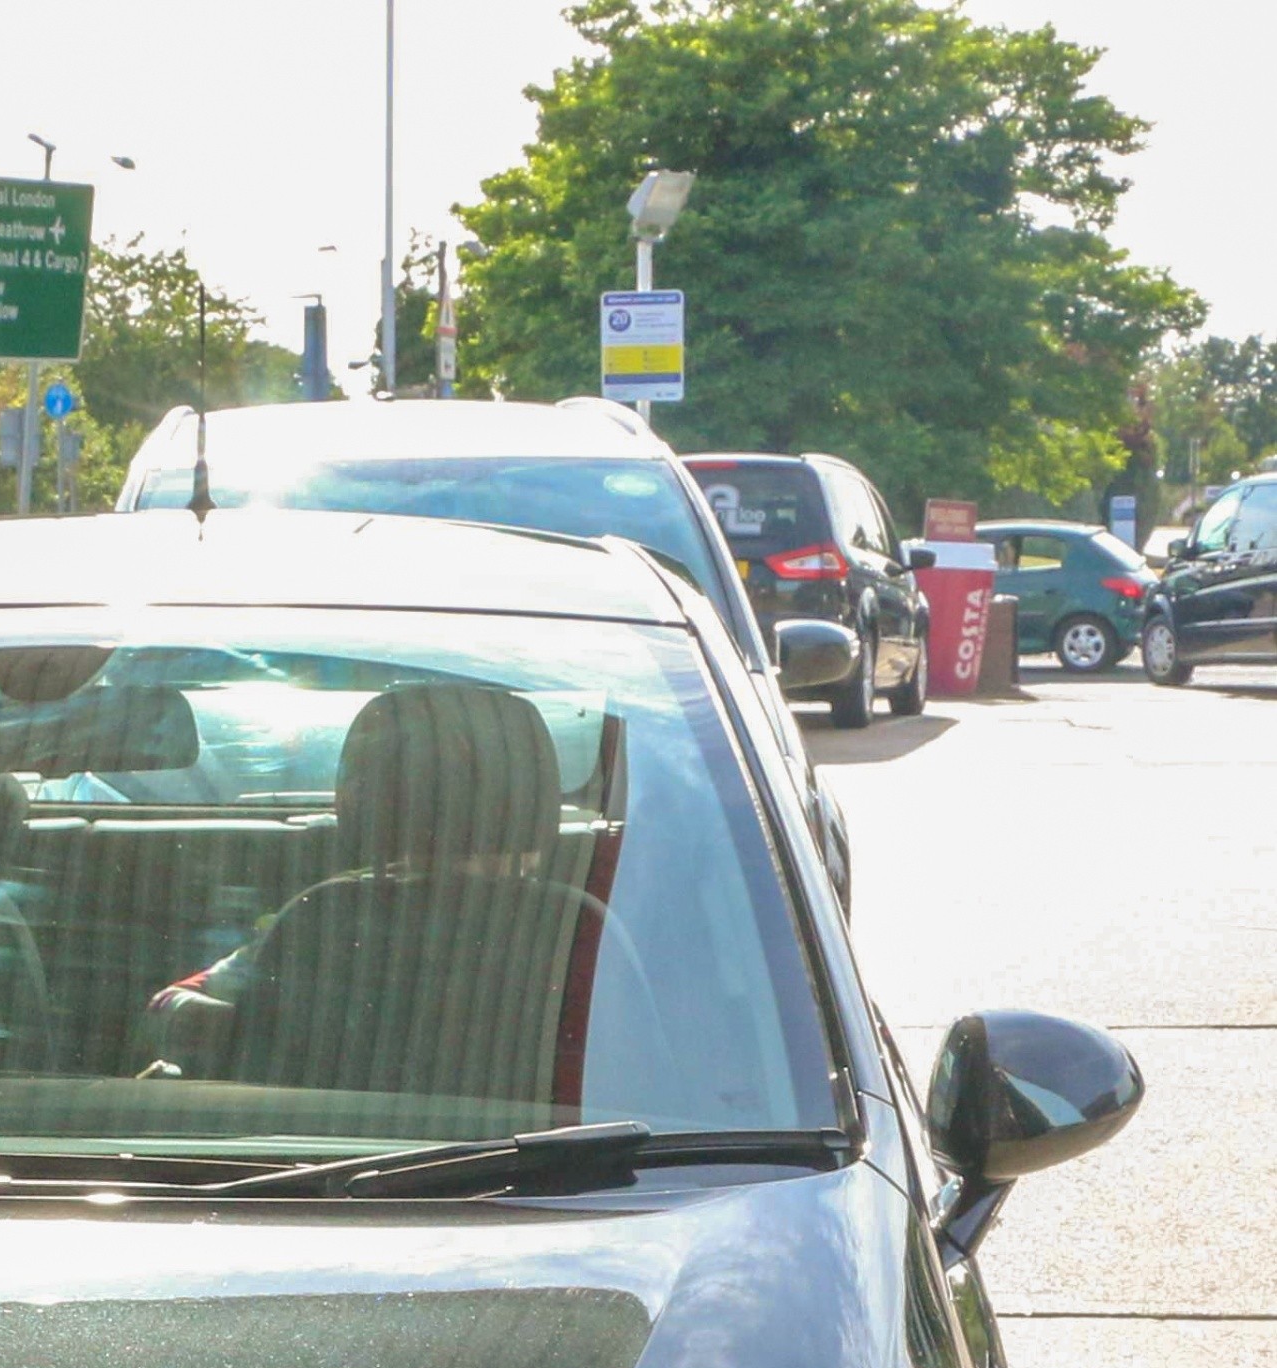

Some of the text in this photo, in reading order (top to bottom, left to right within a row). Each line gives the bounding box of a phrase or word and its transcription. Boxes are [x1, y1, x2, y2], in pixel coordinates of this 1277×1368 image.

[12, 188, 56, 207] London
[21, 249, 30, 267] 4
[955, 588, 985, 681] COSTA
